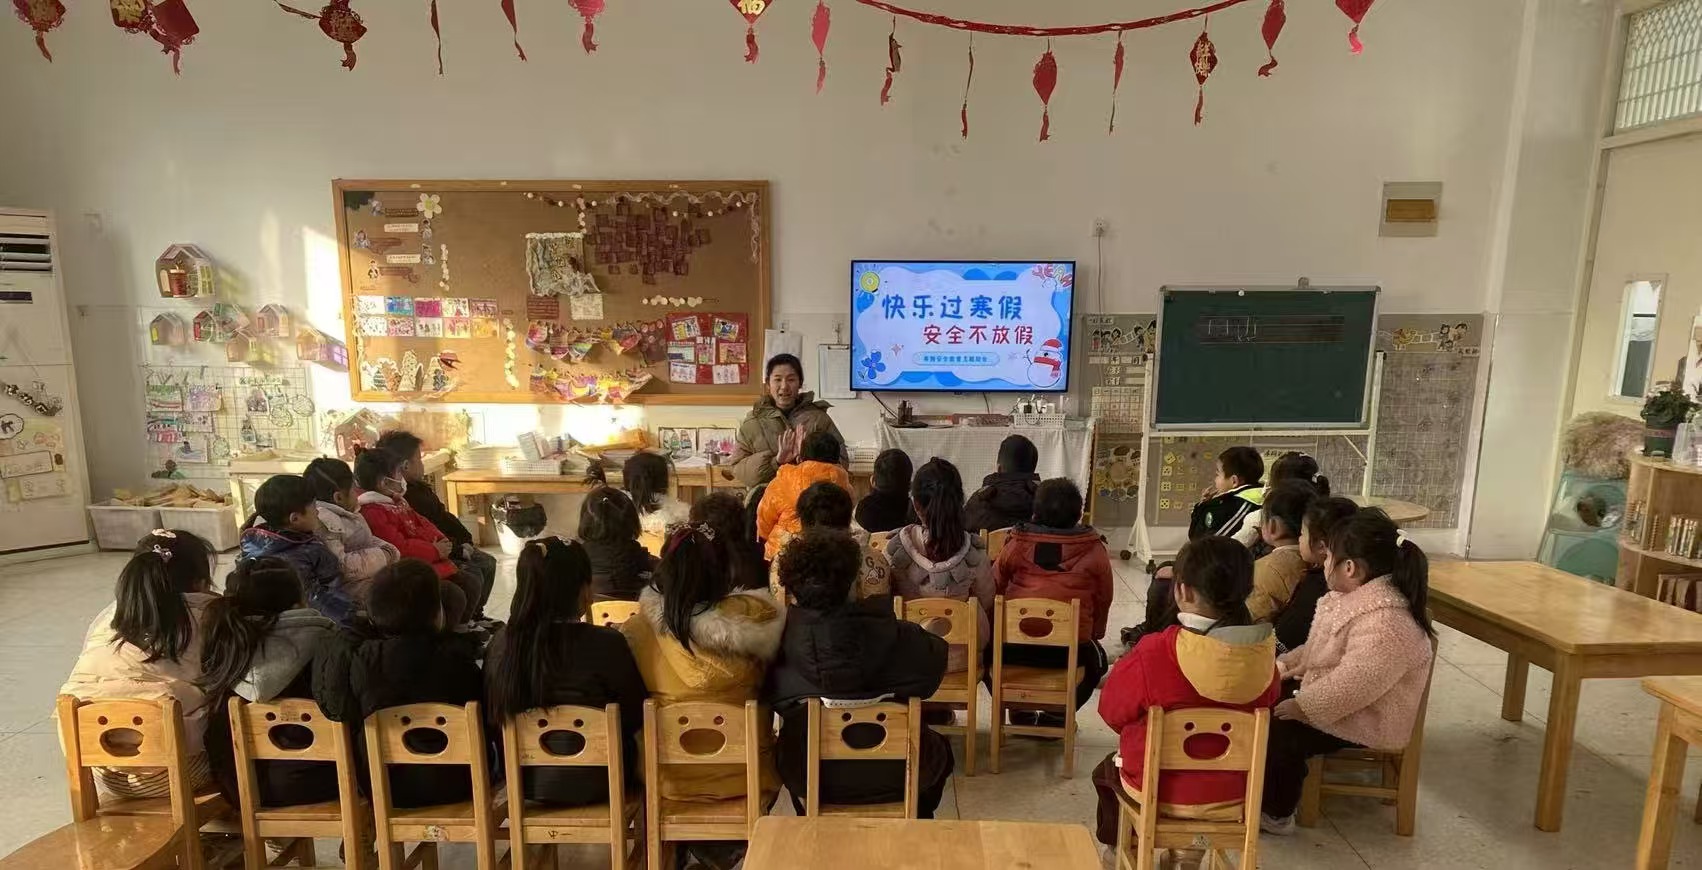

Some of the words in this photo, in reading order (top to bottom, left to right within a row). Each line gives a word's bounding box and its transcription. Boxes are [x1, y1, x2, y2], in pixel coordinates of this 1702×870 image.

[882, 295, 1023, 320] 快乐过寒假
[923, 325, 1034, 345] 安全不放假
